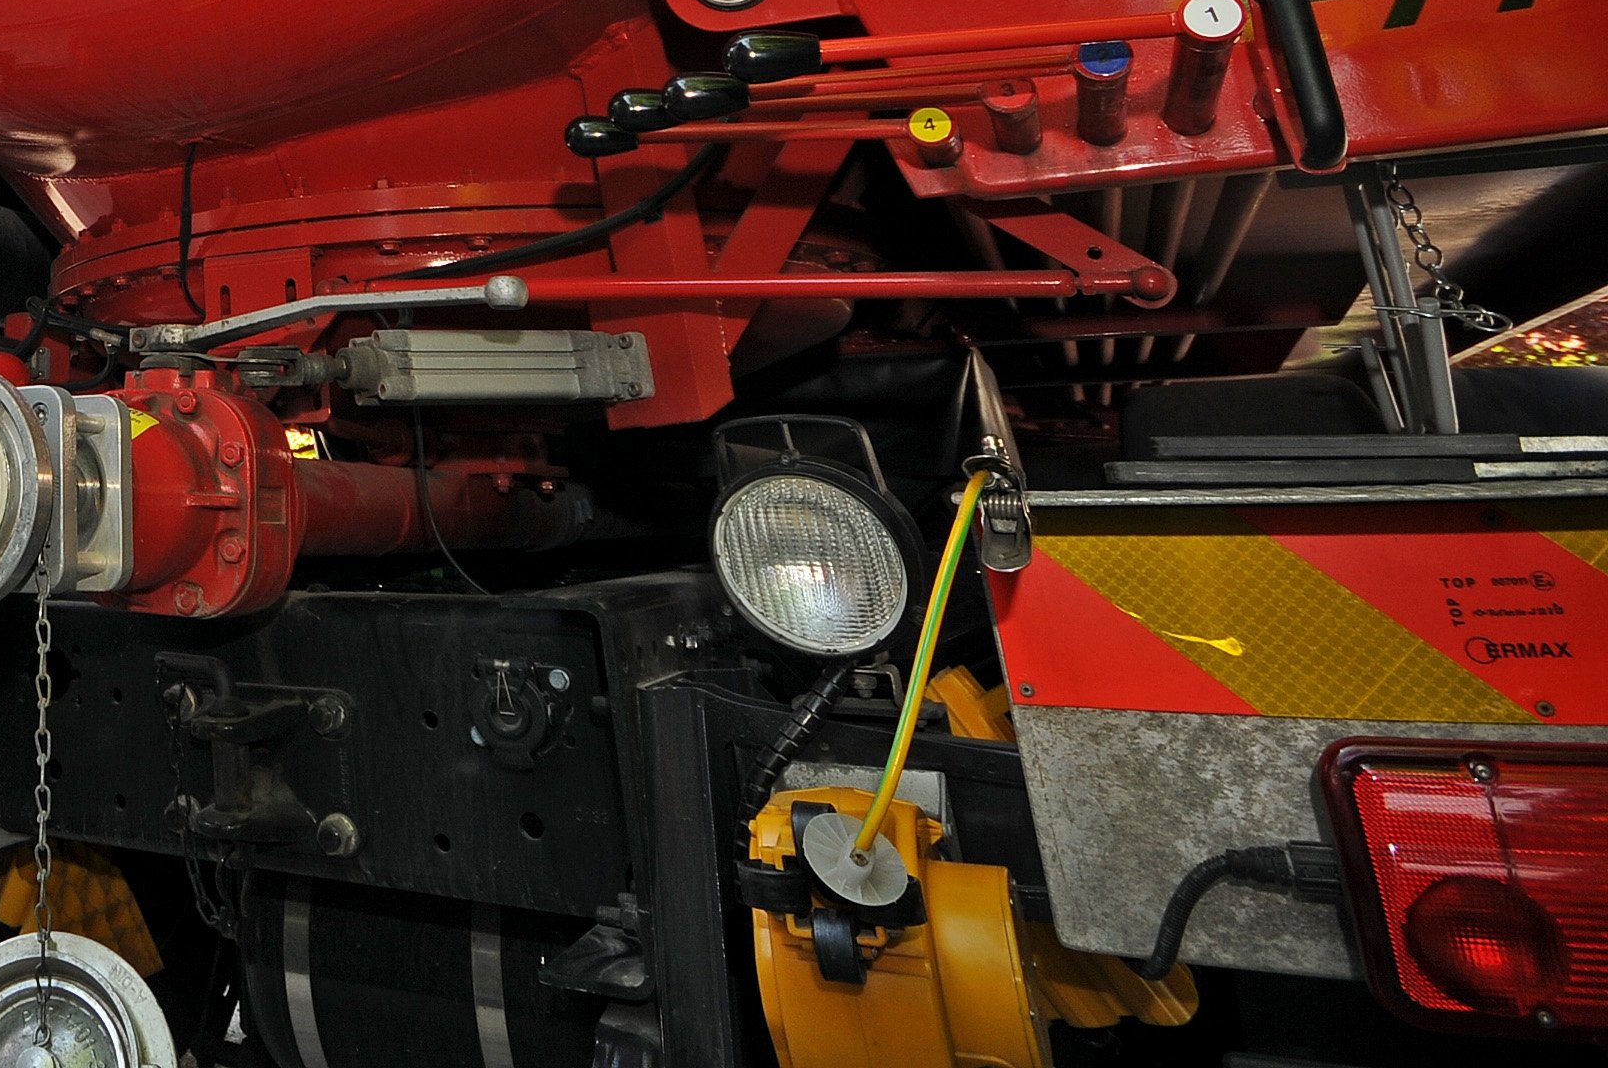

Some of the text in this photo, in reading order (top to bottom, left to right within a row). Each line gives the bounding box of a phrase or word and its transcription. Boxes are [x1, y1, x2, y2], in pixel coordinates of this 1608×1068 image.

[1203, 6, 1219, 24] 1
[923, 116, 937, 132] 4
[1439, 576, 1476, 589] TOP
[1446, 597, 1466, 628] TOP
